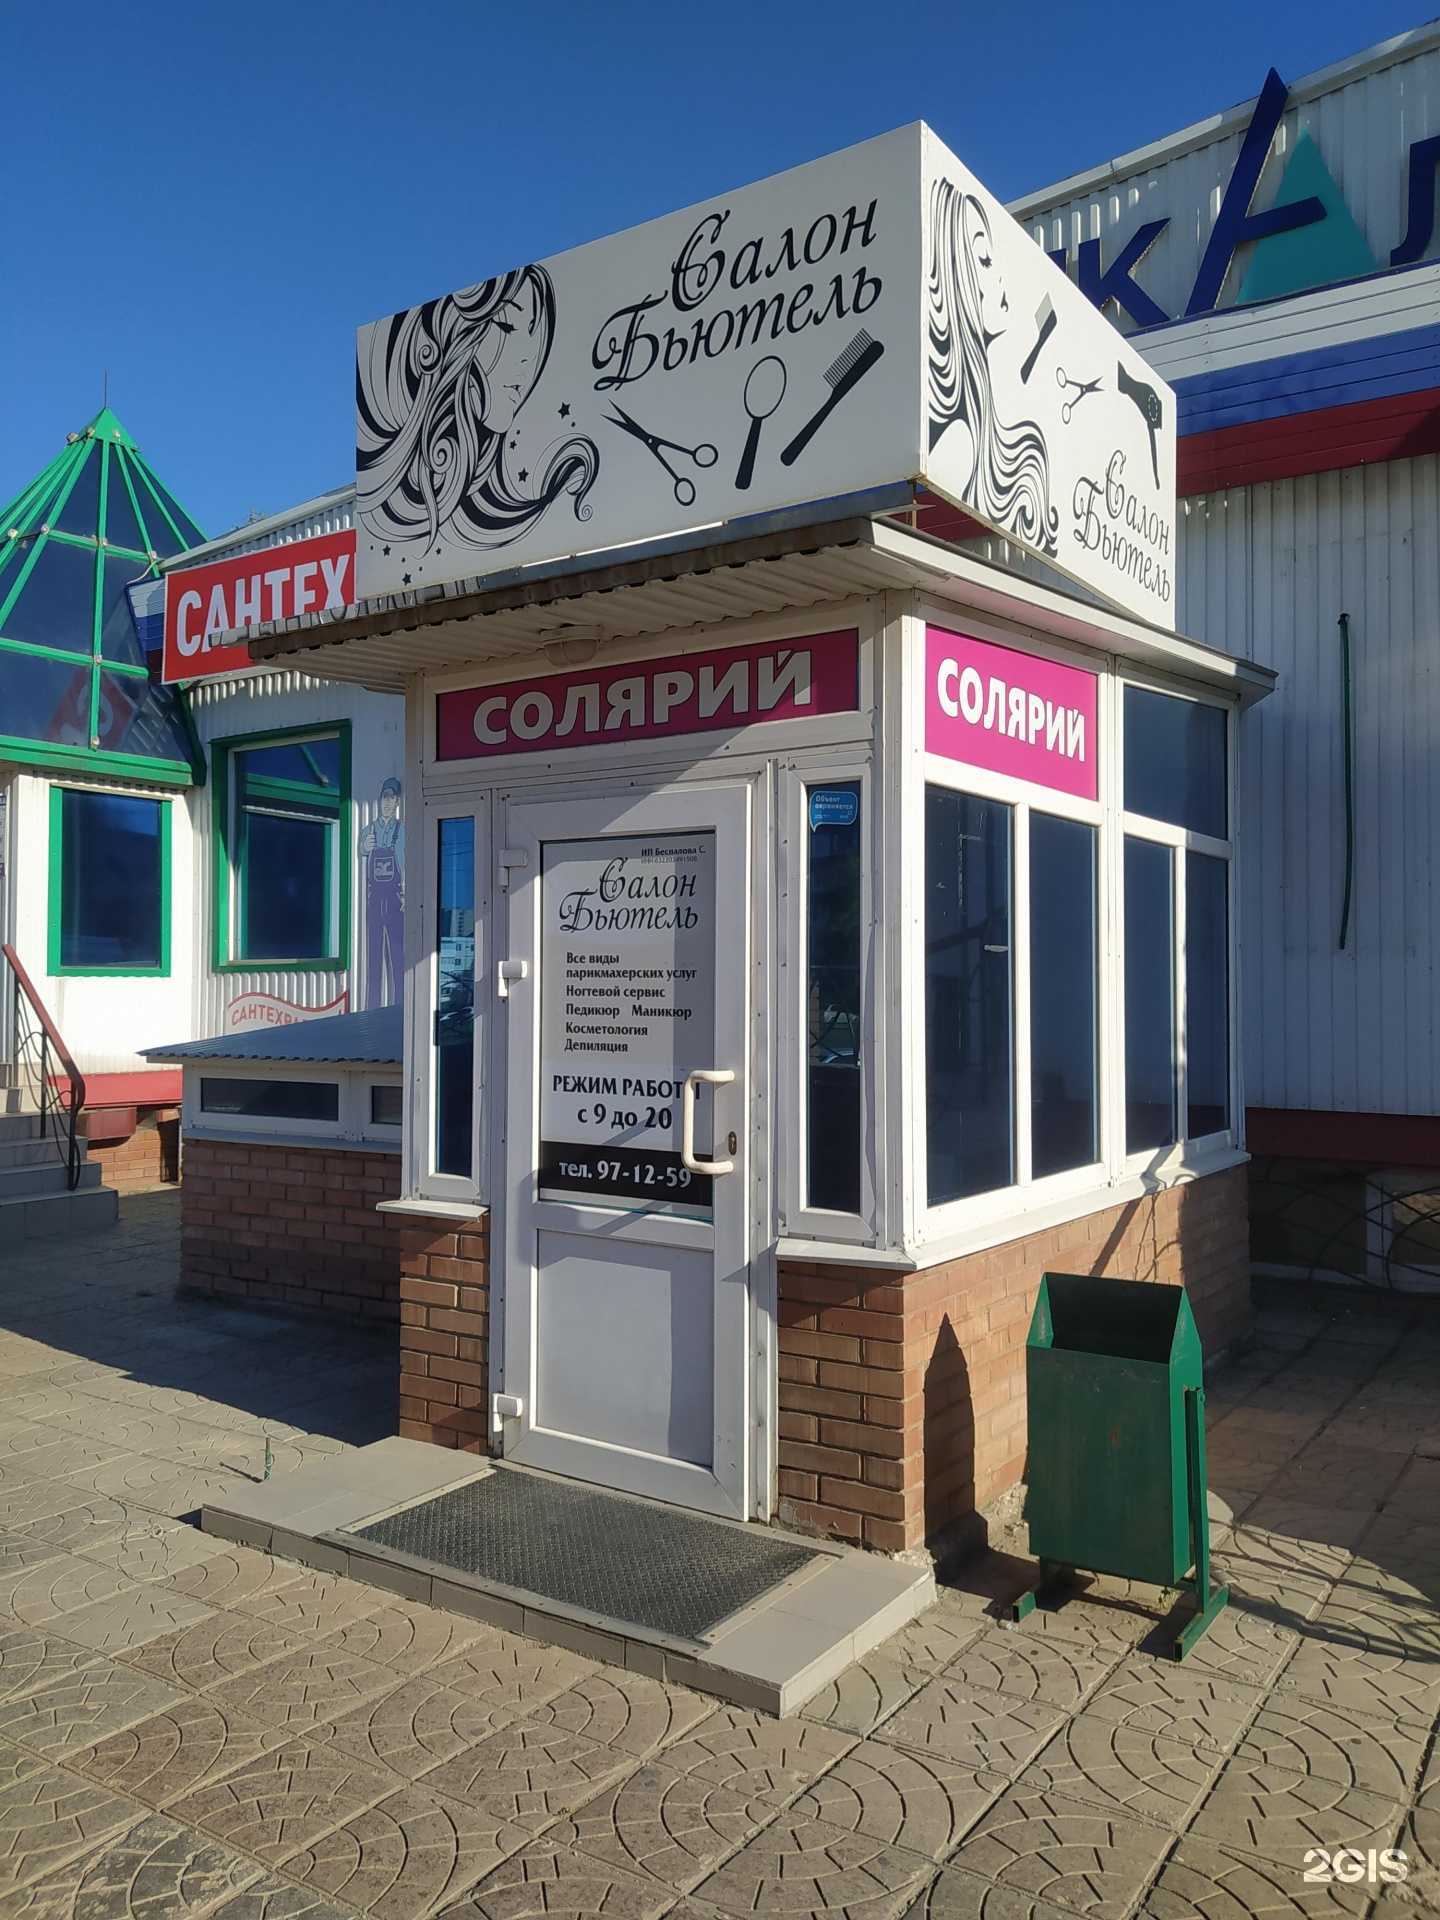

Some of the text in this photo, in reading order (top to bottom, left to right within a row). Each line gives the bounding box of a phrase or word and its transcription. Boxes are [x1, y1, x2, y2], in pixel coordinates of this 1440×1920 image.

[671, 199, 878, 312] Салон
[591, 266, 883, 391] Бьютель
[1105, 450, 1170, 555] Салон
[1073, 477, 1170, 602] Бьютель
[176, 553, 357, 657] САНТЕХ
[474, 650, 812, 745] СОЛЯРИЙ
[937, 658, 1085, 762] СОЛЯРИЙ
[641, 848, 653, 857] ИП
[600, 857, 697, 903] Салон
[559, 888, 698, 933] Бьютель
[566, 952, 620, 966] Все виды
[566, 968, 697, 982] парикмахерских услуг
[566, 985, 666, 1000] Ногтевой сервис
[566, 1003, 692, 1020] Педикюр Маникюр
[565, 1022, 648, 1036] Косметология
[564, 1038, 628, 1053] Депиляция
[553, 1075, 617, 1096] РЕЖИМ
[577, 1103, 672, 1130] с 9 до 20
[559, 1160, 691, 1188] тел. 97-12-59
